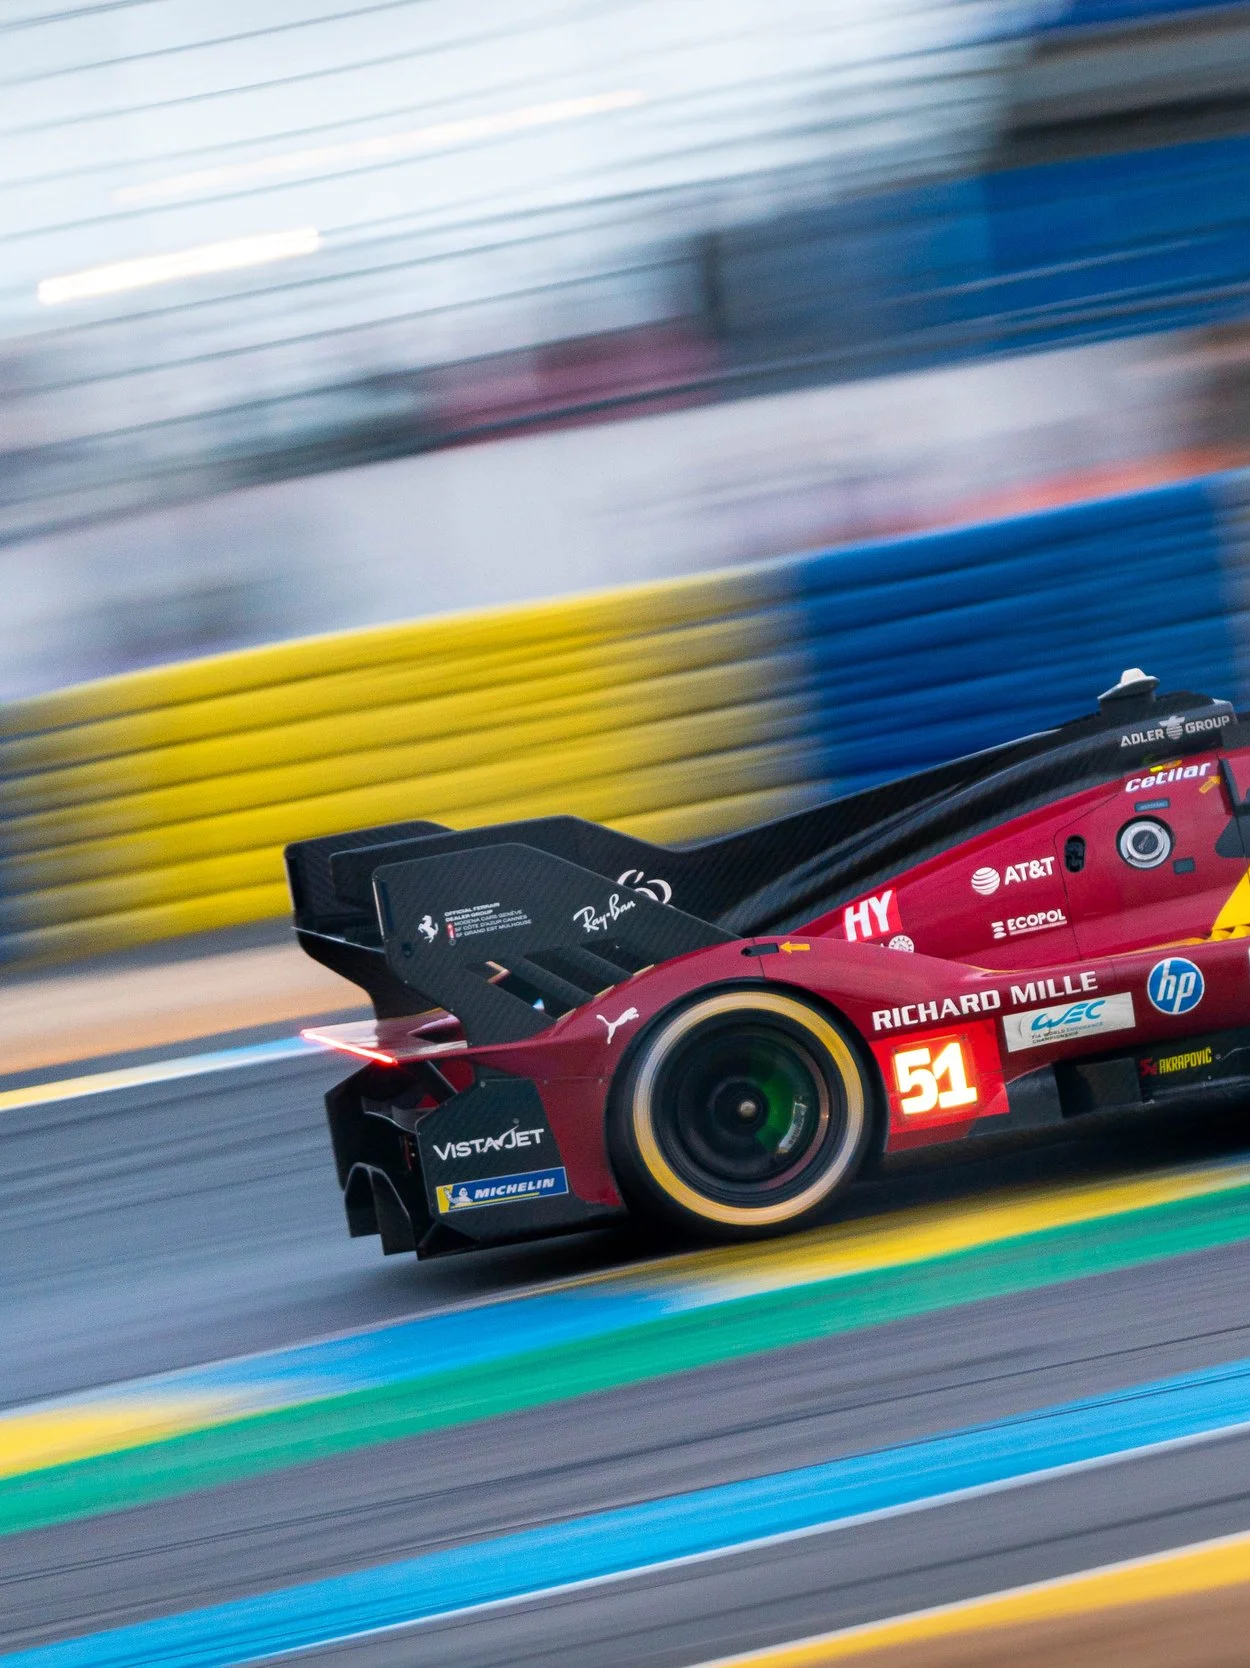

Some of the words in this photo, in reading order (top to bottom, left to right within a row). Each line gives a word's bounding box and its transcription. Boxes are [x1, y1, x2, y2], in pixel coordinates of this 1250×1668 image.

[1120, 728, 1165, 748] ADLER
[1185, 715, 1230, 734] GROUP
[1125, 762, 1211, 793] cetilar
[1005, 856, 1055, 885] AT&T
[444, 908, 472, 917] OFFICIAL
[473, 902, 500, 911] FERRARI
[445, 914, 470, 922] DEALER
[470, 909, 493, 918] GROUP
[573, 893, 636, 932] Ray-Ban
[844, 889, 893, 943] HY
[1007, 908, 1066, 931] ECOPOL
[872, 989, 1001, 1031] RICHARD
[1010, 971, 1099, 1005] MILLE
[1156, 958, 1197, 1014] hp
[1031, 999, 1106, 1031] WEC
[894, 1041, 978, 1116] 51
[474, 1177, 555, 1200] MICHELIN
